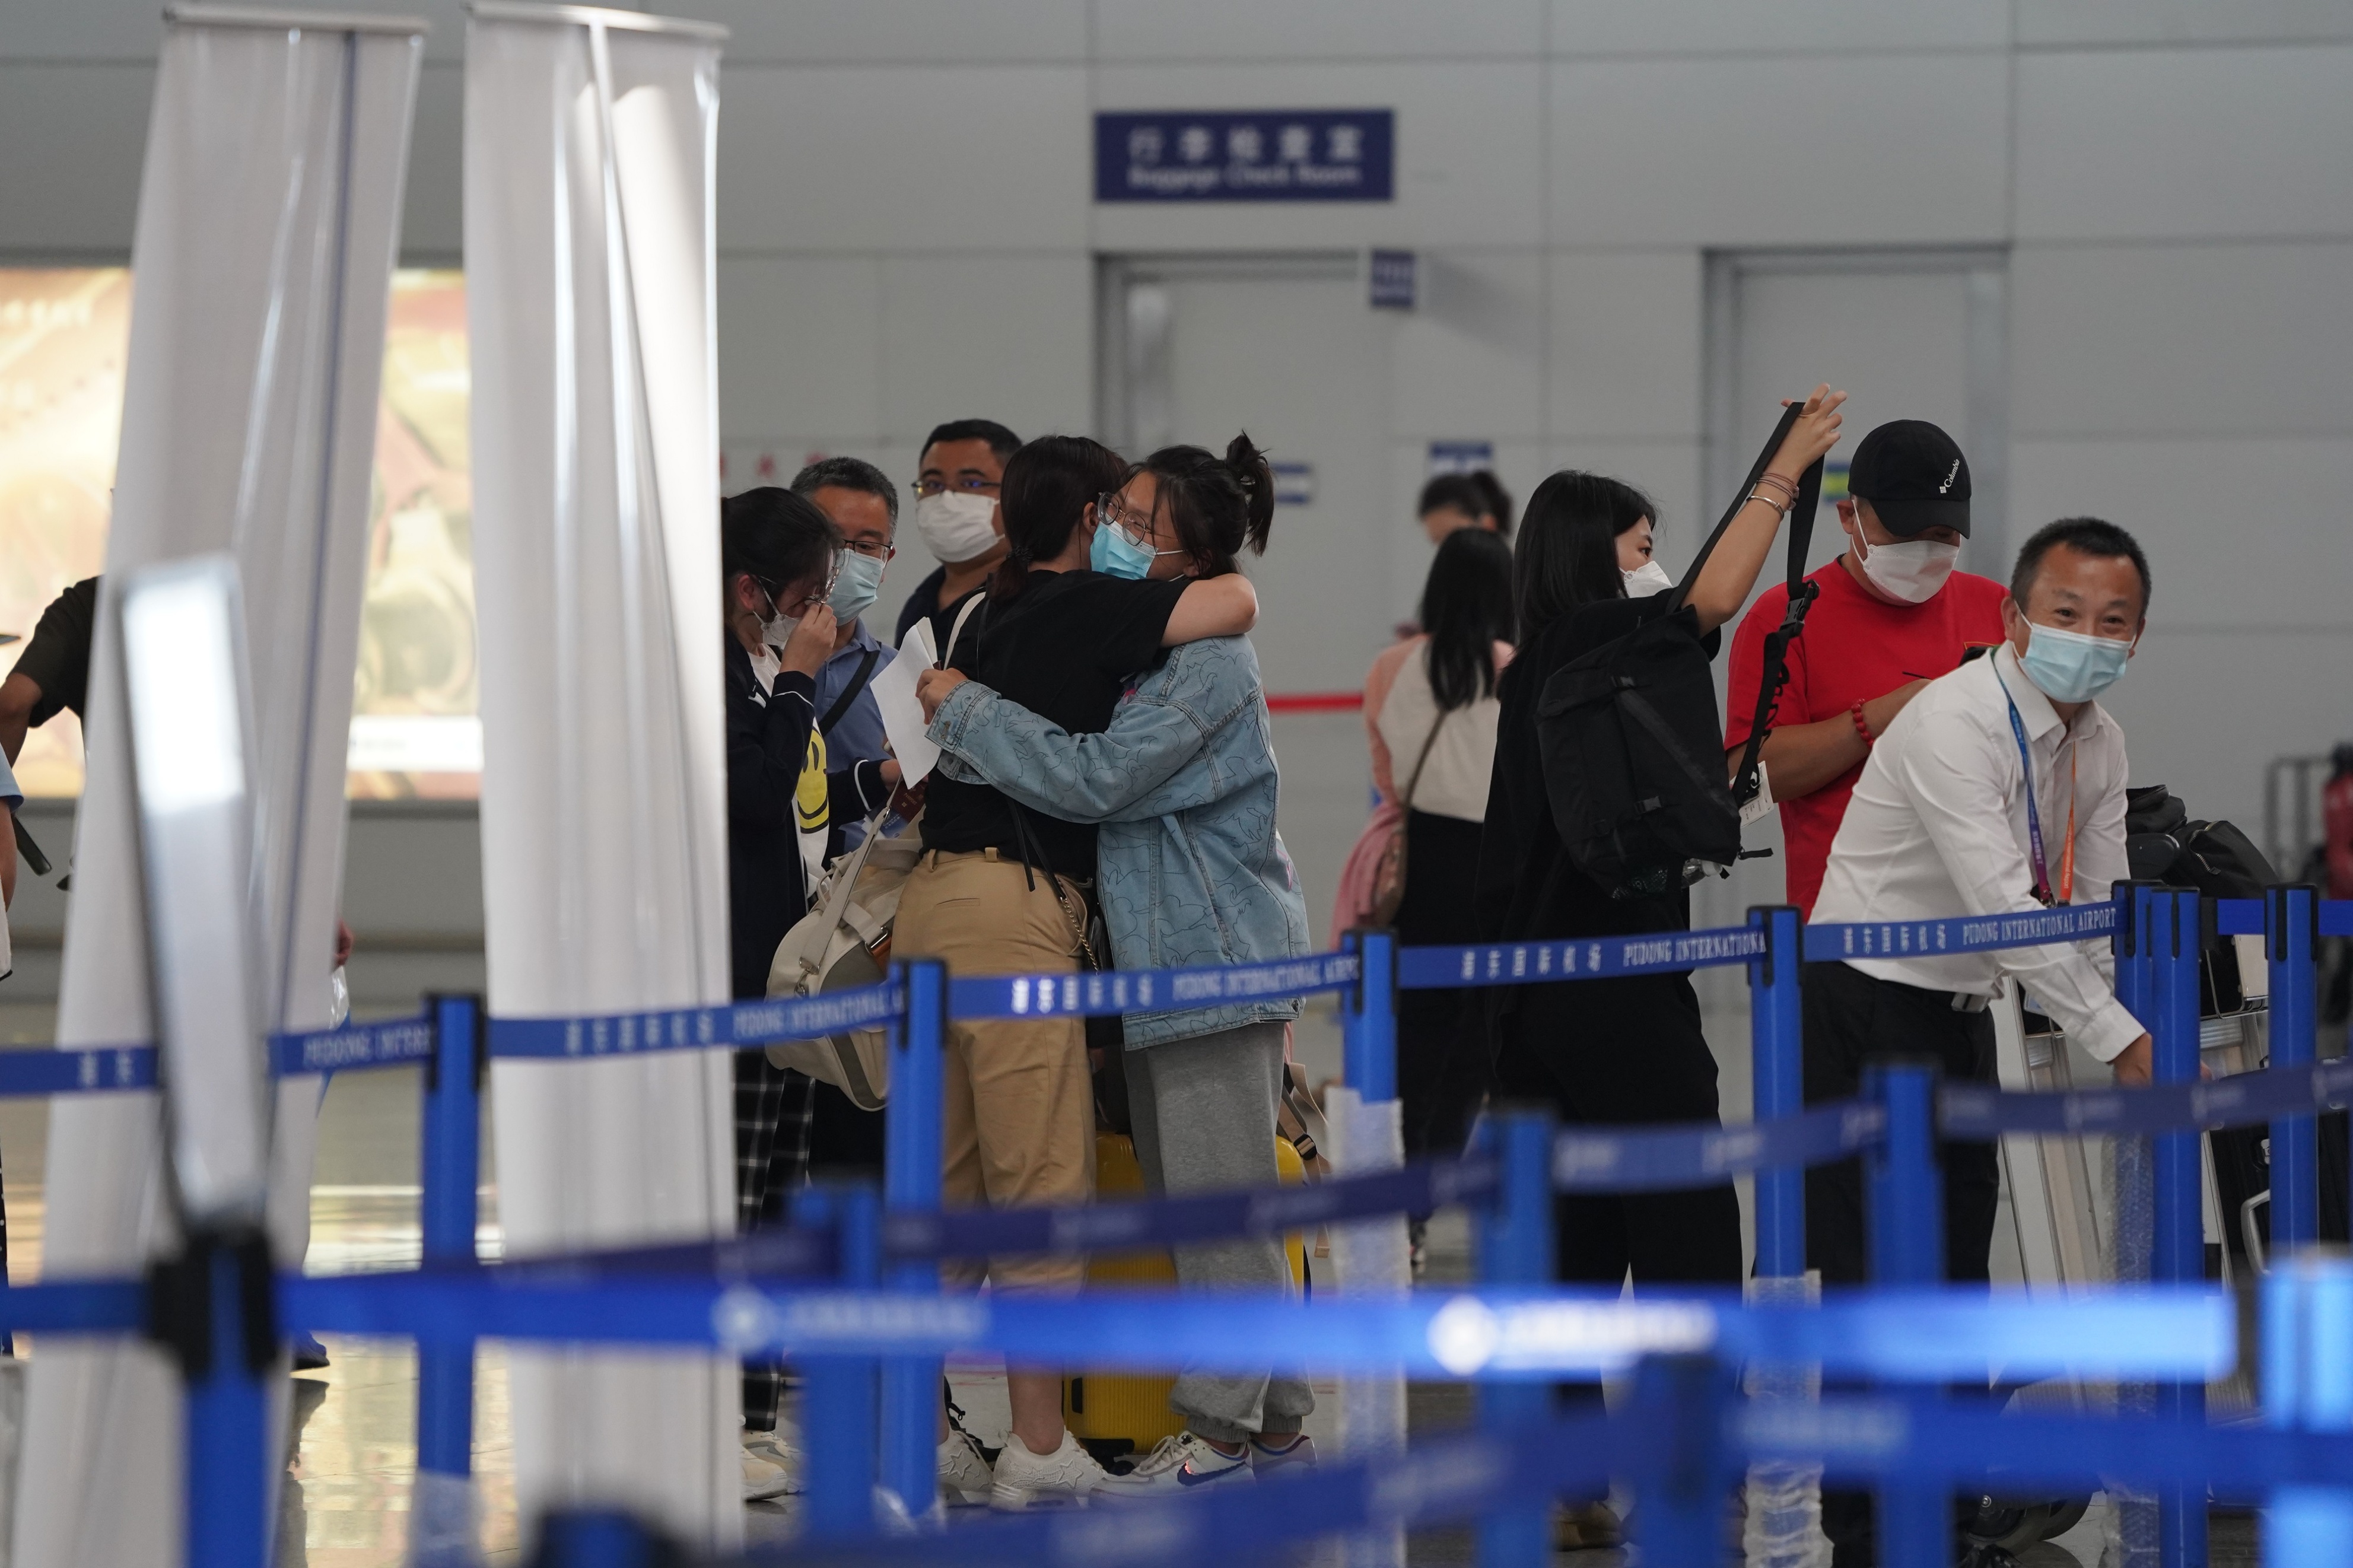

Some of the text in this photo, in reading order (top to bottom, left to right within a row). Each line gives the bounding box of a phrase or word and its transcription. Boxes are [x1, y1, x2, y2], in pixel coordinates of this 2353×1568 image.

[1944, 459, 1960, 488] Columbia
[1963, 907, 2116, 945] PUDONG INTERNATIONAL AIRPORT
[1623, 939, 1672, 967] PUDONG
